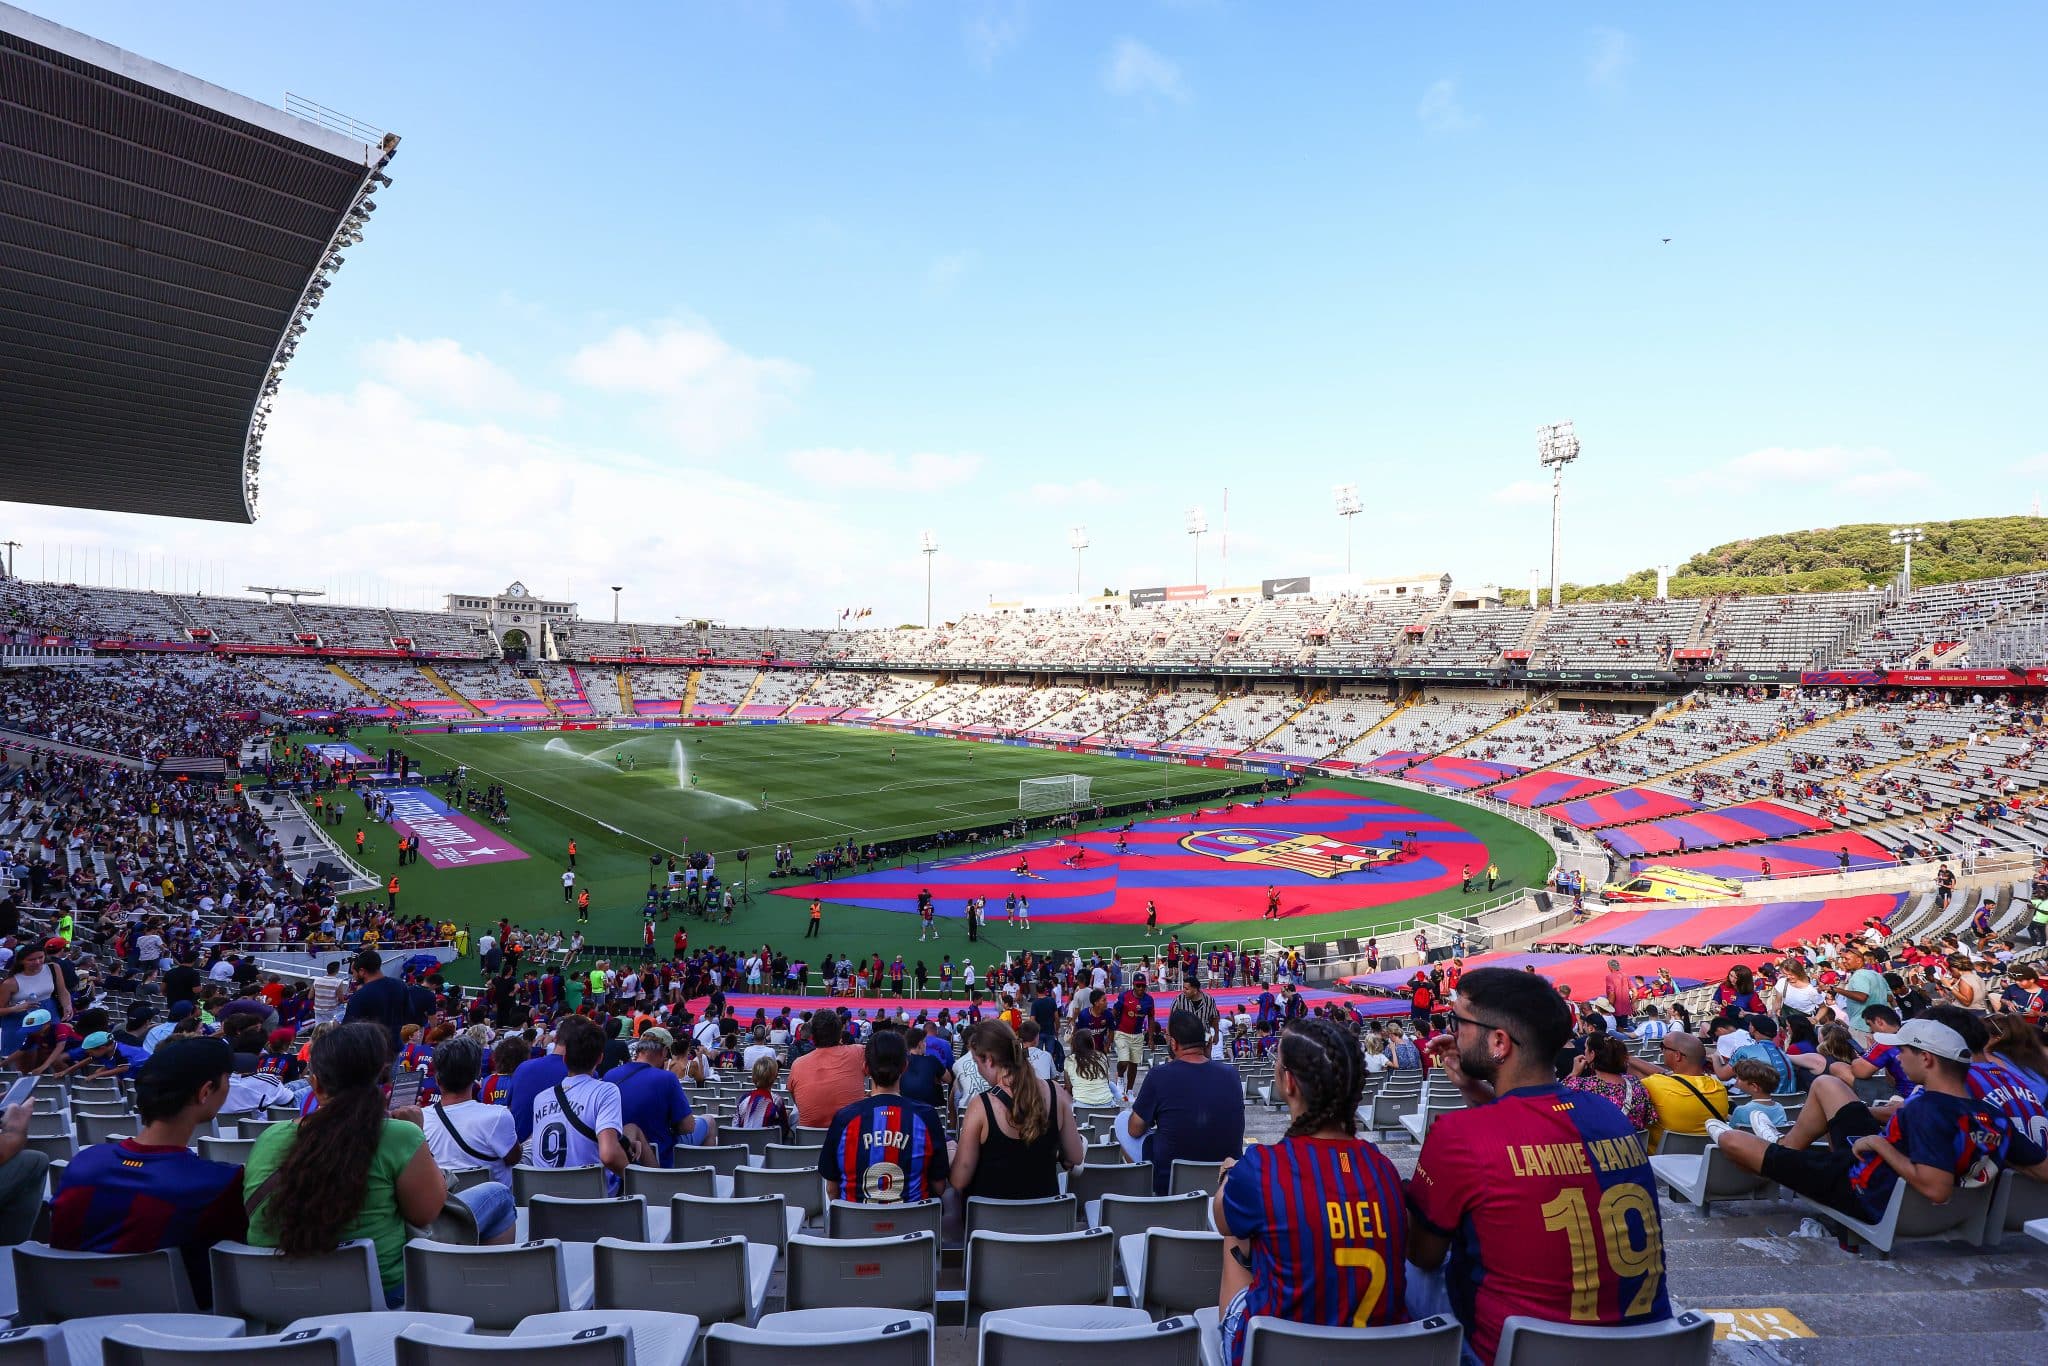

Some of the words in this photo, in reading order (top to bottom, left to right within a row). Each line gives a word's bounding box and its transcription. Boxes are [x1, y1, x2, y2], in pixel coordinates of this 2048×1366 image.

[1251, 765, 1268, 773] GAMPER
[944, 967, 951, 976] 10
[539, 1122, 567, 1168] 9
[862, 1130, 910, 1150] PEDRI
[1506, 1142, 1592, 1176] LAMINE
[1326, 1201, 1387, 1239] BIEL
[1541, 1182, 1664, 1320] 19
[1334, 1248, 1386, 1328] 7
